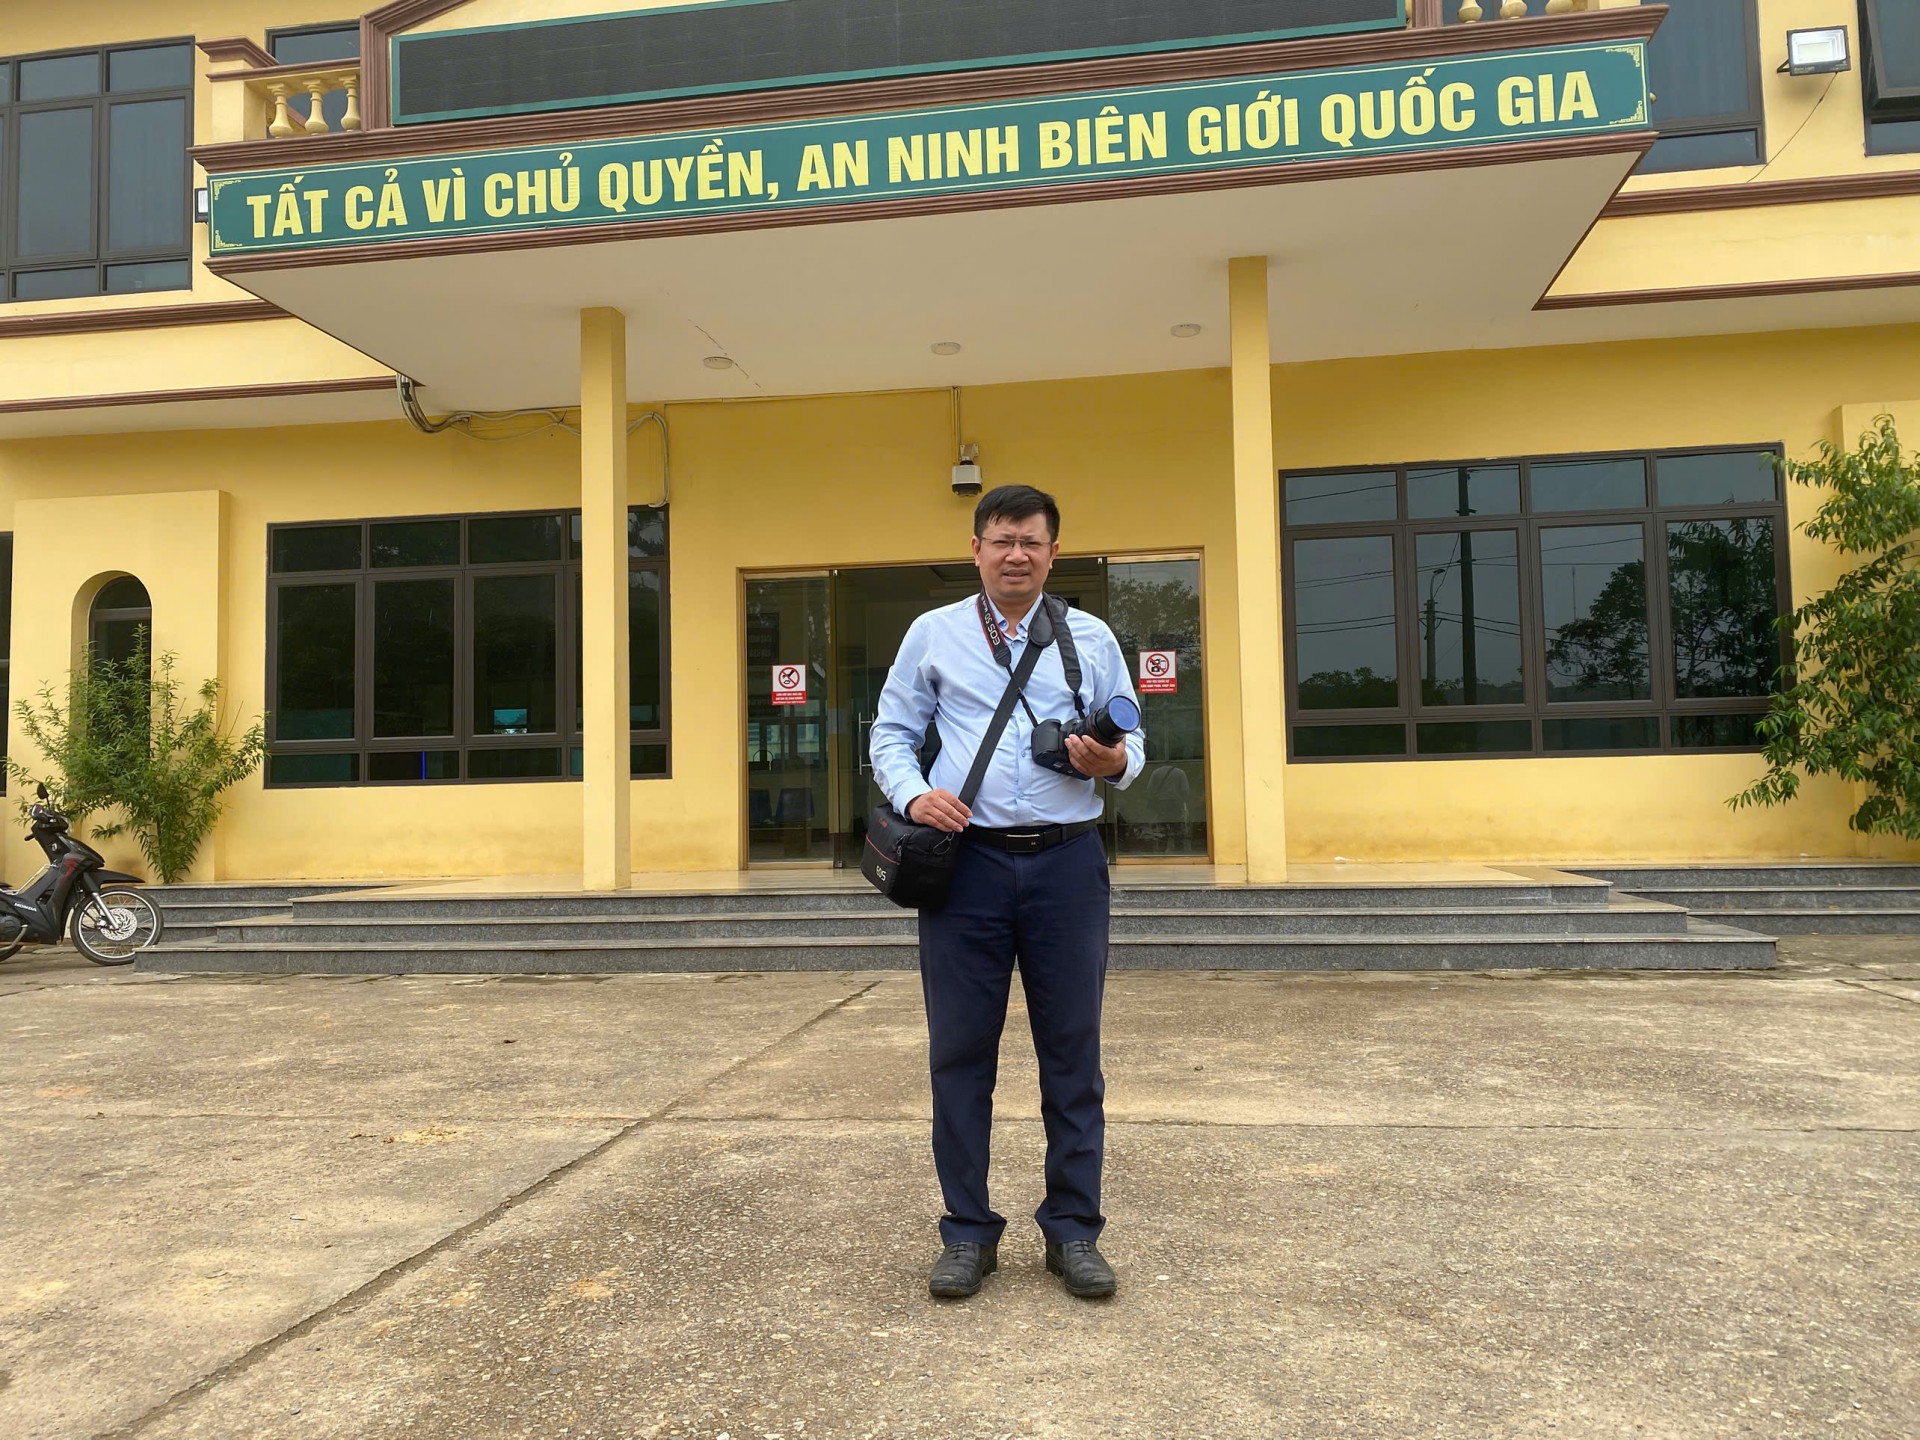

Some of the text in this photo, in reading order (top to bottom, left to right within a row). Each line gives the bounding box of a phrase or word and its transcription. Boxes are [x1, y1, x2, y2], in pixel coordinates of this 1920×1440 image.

[246, 68, 1599, 238] TẤT CẢ VÌ CHỦ QUYỀN, AN NINH BIÊN GIỚI QUỐC GIA
[988, 624, 1000, 645] EOS
